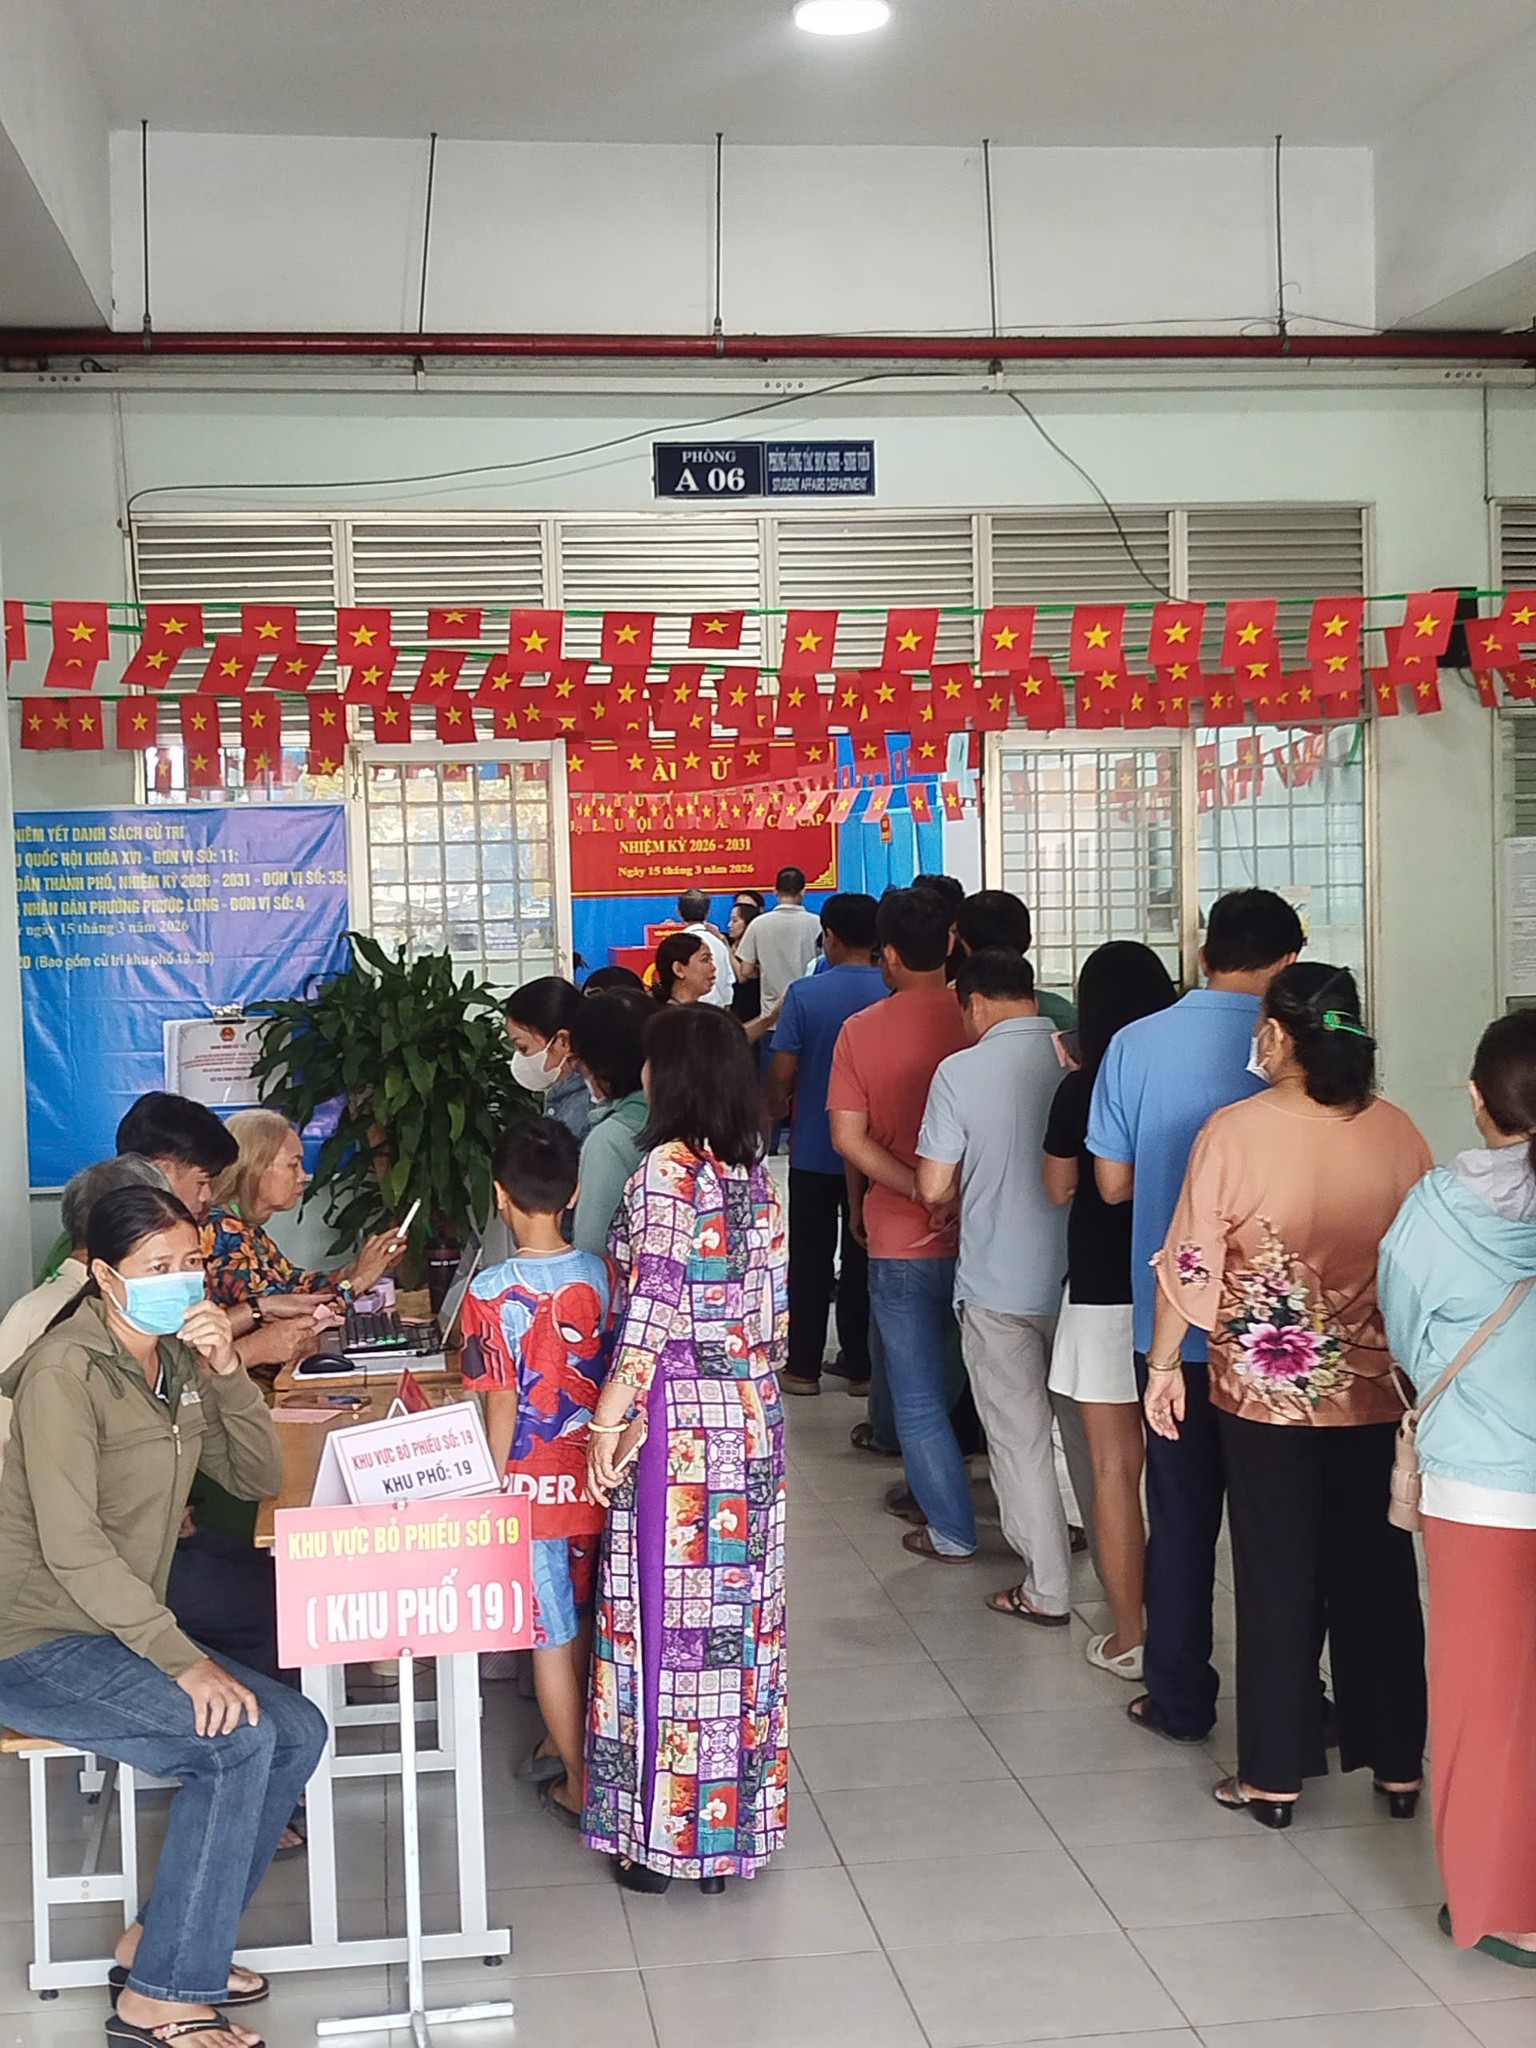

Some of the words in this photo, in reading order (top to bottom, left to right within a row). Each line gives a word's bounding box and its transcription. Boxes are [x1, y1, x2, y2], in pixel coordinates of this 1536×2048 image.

[682, 448, 736, 463] PHÒNG
[675, 468, 699, 491] A
[708, 467, 745, 491] 06
[772, 477, 800, 492] STUDENT
[801, 477, 825, 491] AFFAIRS
[826, 476, 867, 491] DEPARTMENT
[47, 823, 69, 841] YẾT
[72, 826, 106, 841] DANH
[109, 823, 142, 841] SÁCH
[145, 821, 162, 840] CỬ
[165, 825, 186, 840] TRI
[25, 848, 58, 867] QUỐC
[61, 850, 82, 870] HỘI
[86, 849, 119, 866] KHÓA
[122, 851, 142, 865] XVI
[153, 849, 178, 865] ĐƠN
[181, 850, 194, 866] VỊ
[197, 845, 217, 863] SỐ:
[220, 849, 239, 863] 11;
[619, 839, 664, 856] NHIỆM
[667, 836, 687, 853] KỲ
[689, 840, 716, 853] 2026
[725, 838, 751, 851] 2031
[44, 873, 84, 891] THÀNH
[87, 871, 117, 892] PHỐ,
[119, 873, 160, 892] NHIỆM
[162, 871, 178, 889] KỲ
[181, 873, 211, 888] 2026
[222, 872, 250, 887] 2031
[263, 870, 288, 887] ĐƠN
[291, 871, 303, 888] VỊ
[306, 866, 326, 885] SỐ:
[618, 866, 645, 878] Ngày
[648, 866, 661, 876] 15
[662, 865, 694, 877] tháng
[694, 865, 702, 875] 3
[703, 865, 727, 875] năm
[729, 863, 755, 874] 2026
[23, 898, 58, 916] NHÂN
[61, 898, 87, 915] DÂN
[187, 897, 220, 912] LONG
[258, 896, 271, 913] VỊ
[273, 891, 293, 910] SỐ:
[295, 895, 305, 910] 4
[61, 922, 75, 935] 15
[78, 922, 114, 937] tháng
[117, 921, 125, 934] 3
[128, 921, 156, 933] năm
[160, 919, 189, 933] 2026
[110, 954, 124, 967] tri
[351, 1451, 375, 1471] KHU
[376, 1446, 396, 1468] VỰC
[397, 1438, 412, 1461] BỎ
[412, 1432, 442, 1457] PHIẾU
[442, 1427, 460, 1450] SỐ:
[460, 1430, 474, 1446] 19
[382, 1473, 414, 1494] KHU
[416, 1460, 453, 1487] PHỐ:
[454, 1460, 473, 1477] 19
[288, 1530, 327, 1560] KHU
[331, 1526, 370, 1561] VỰC
[374, 1517, 401, 1554] BỎ
[405, 1513, 461, 1550] PHIẾU
[465, 1509, 492, 1547] SỐ
[496, 1516, 520, 1545] 19
[397, 1567, 459, 1638] PHỐ
